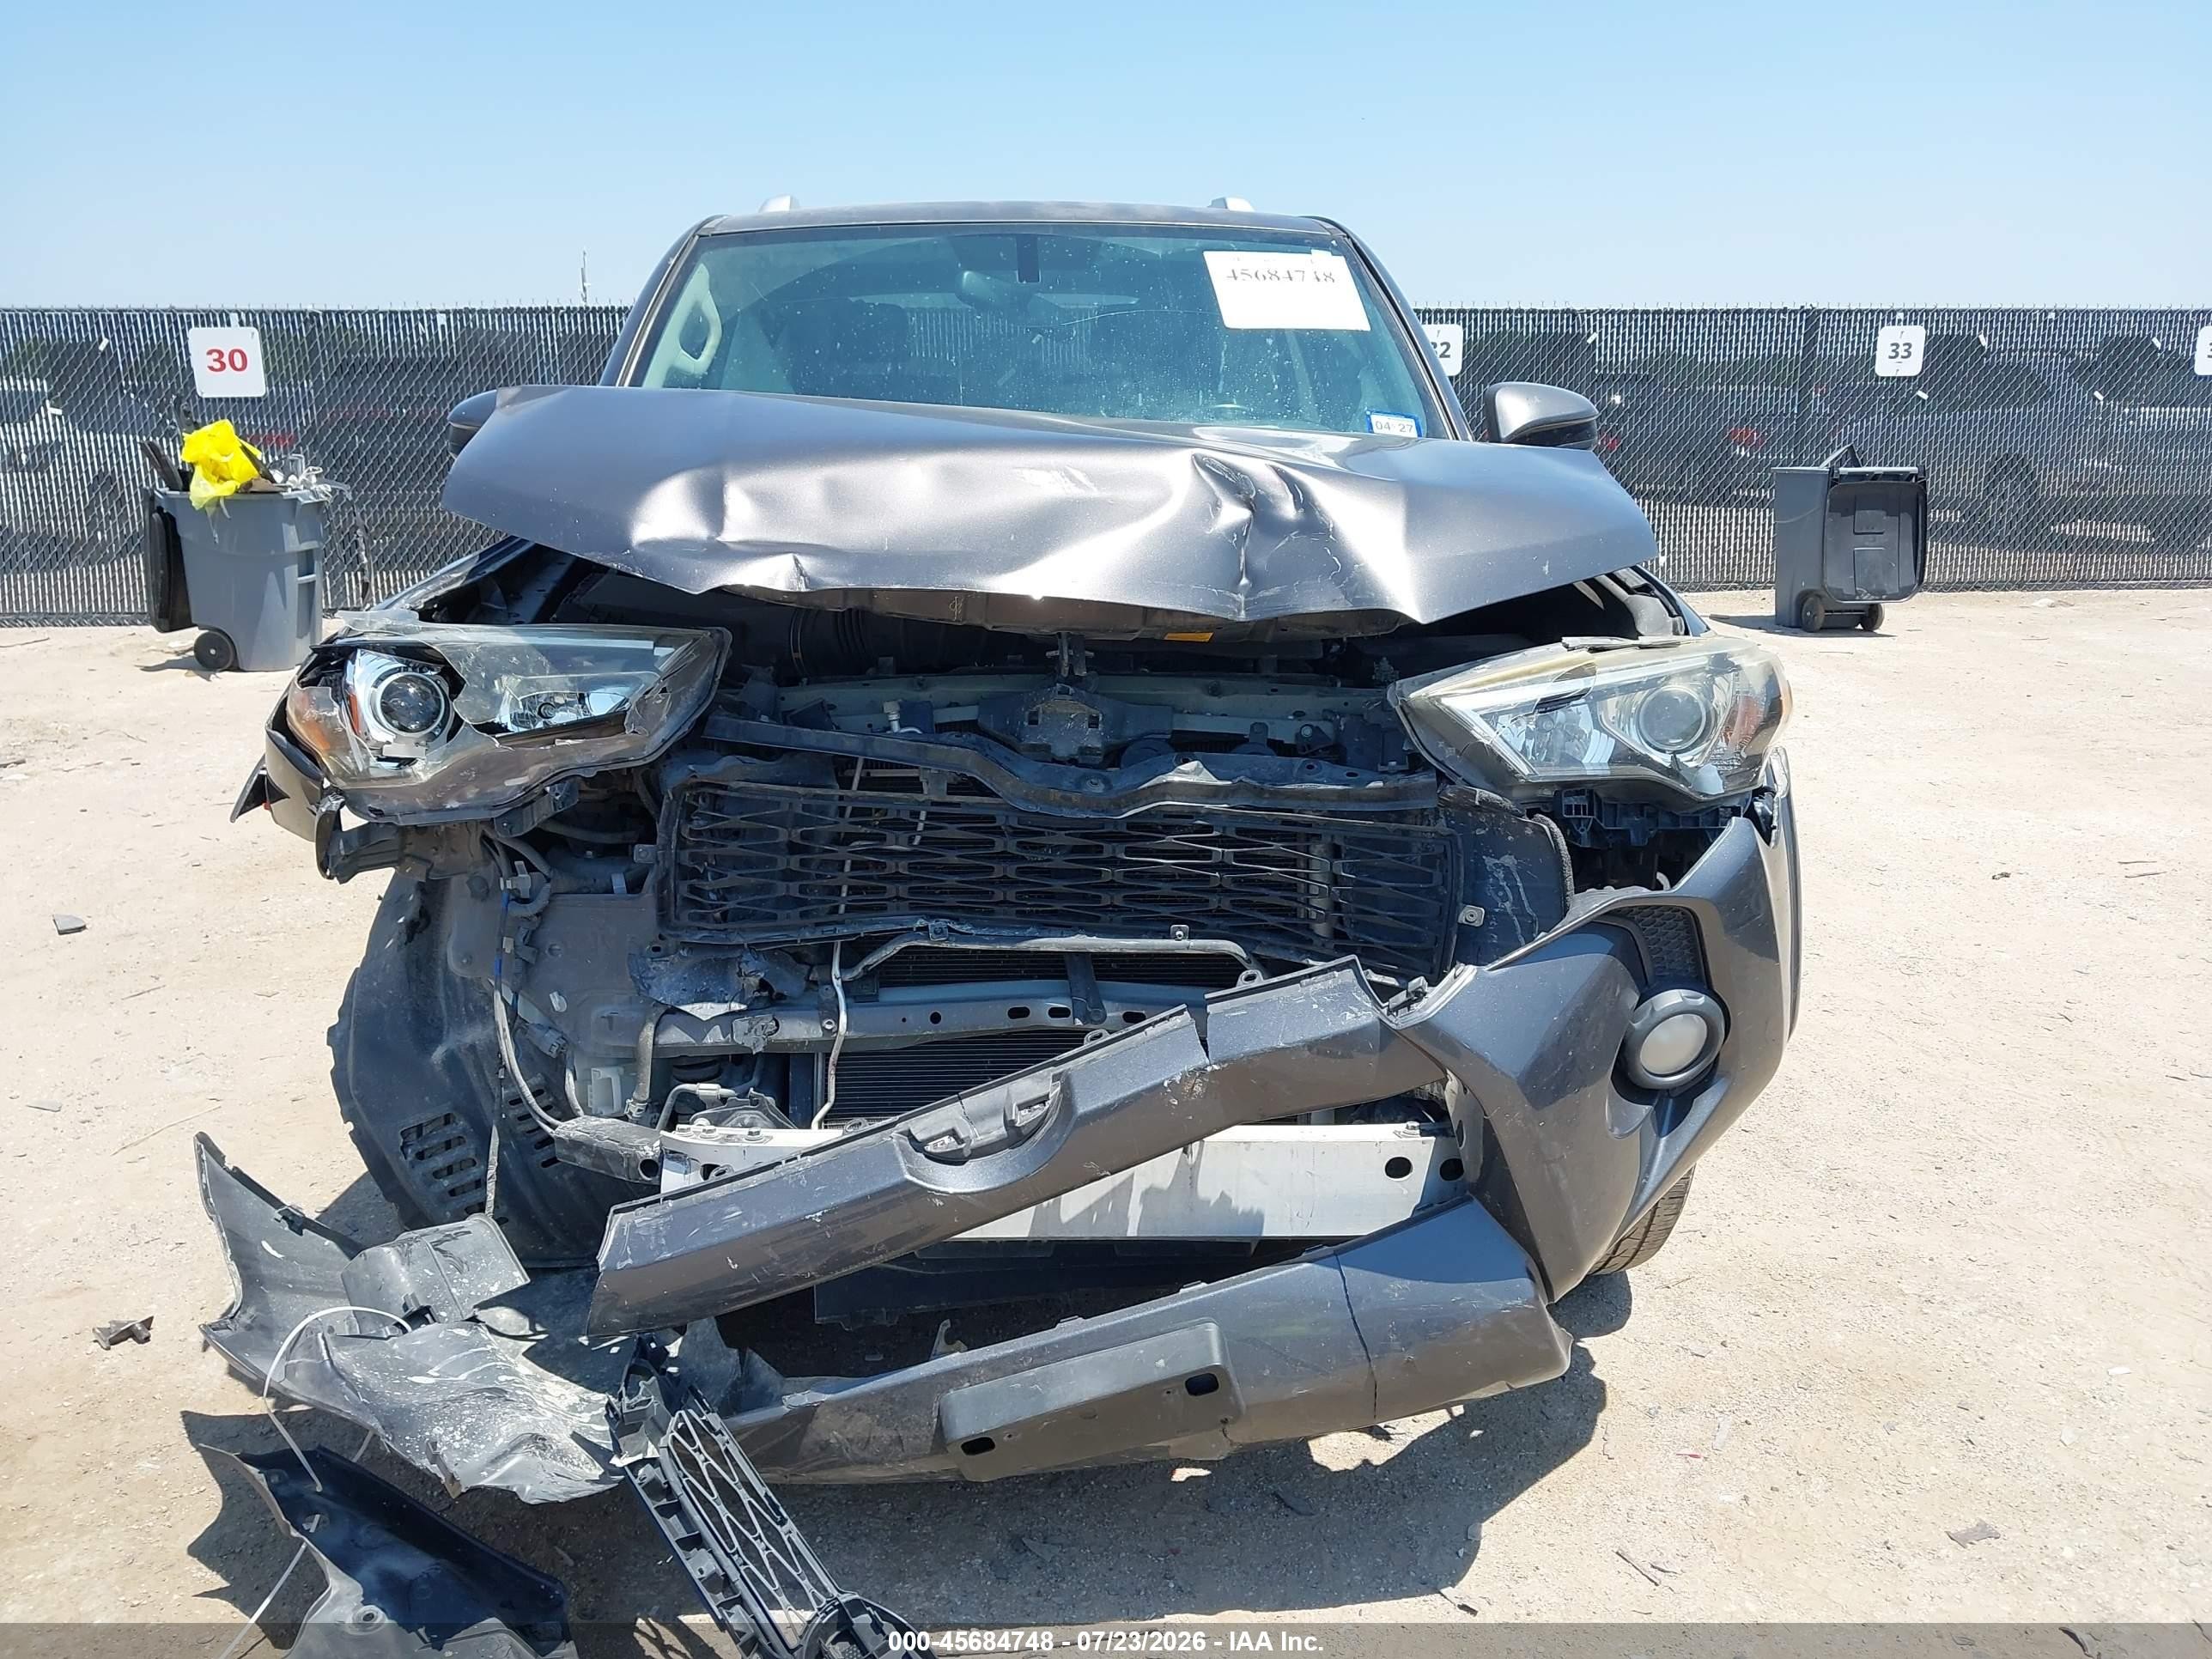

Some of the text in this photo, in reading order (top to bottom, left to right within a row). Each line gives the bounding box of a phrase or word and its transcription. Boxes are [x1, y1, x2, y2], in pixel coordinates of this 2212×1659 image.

[1888, 342, 1912, 360] 33
[206, 349, 248, 373] 30
[1375, 420, 1413, 433] 04 27
